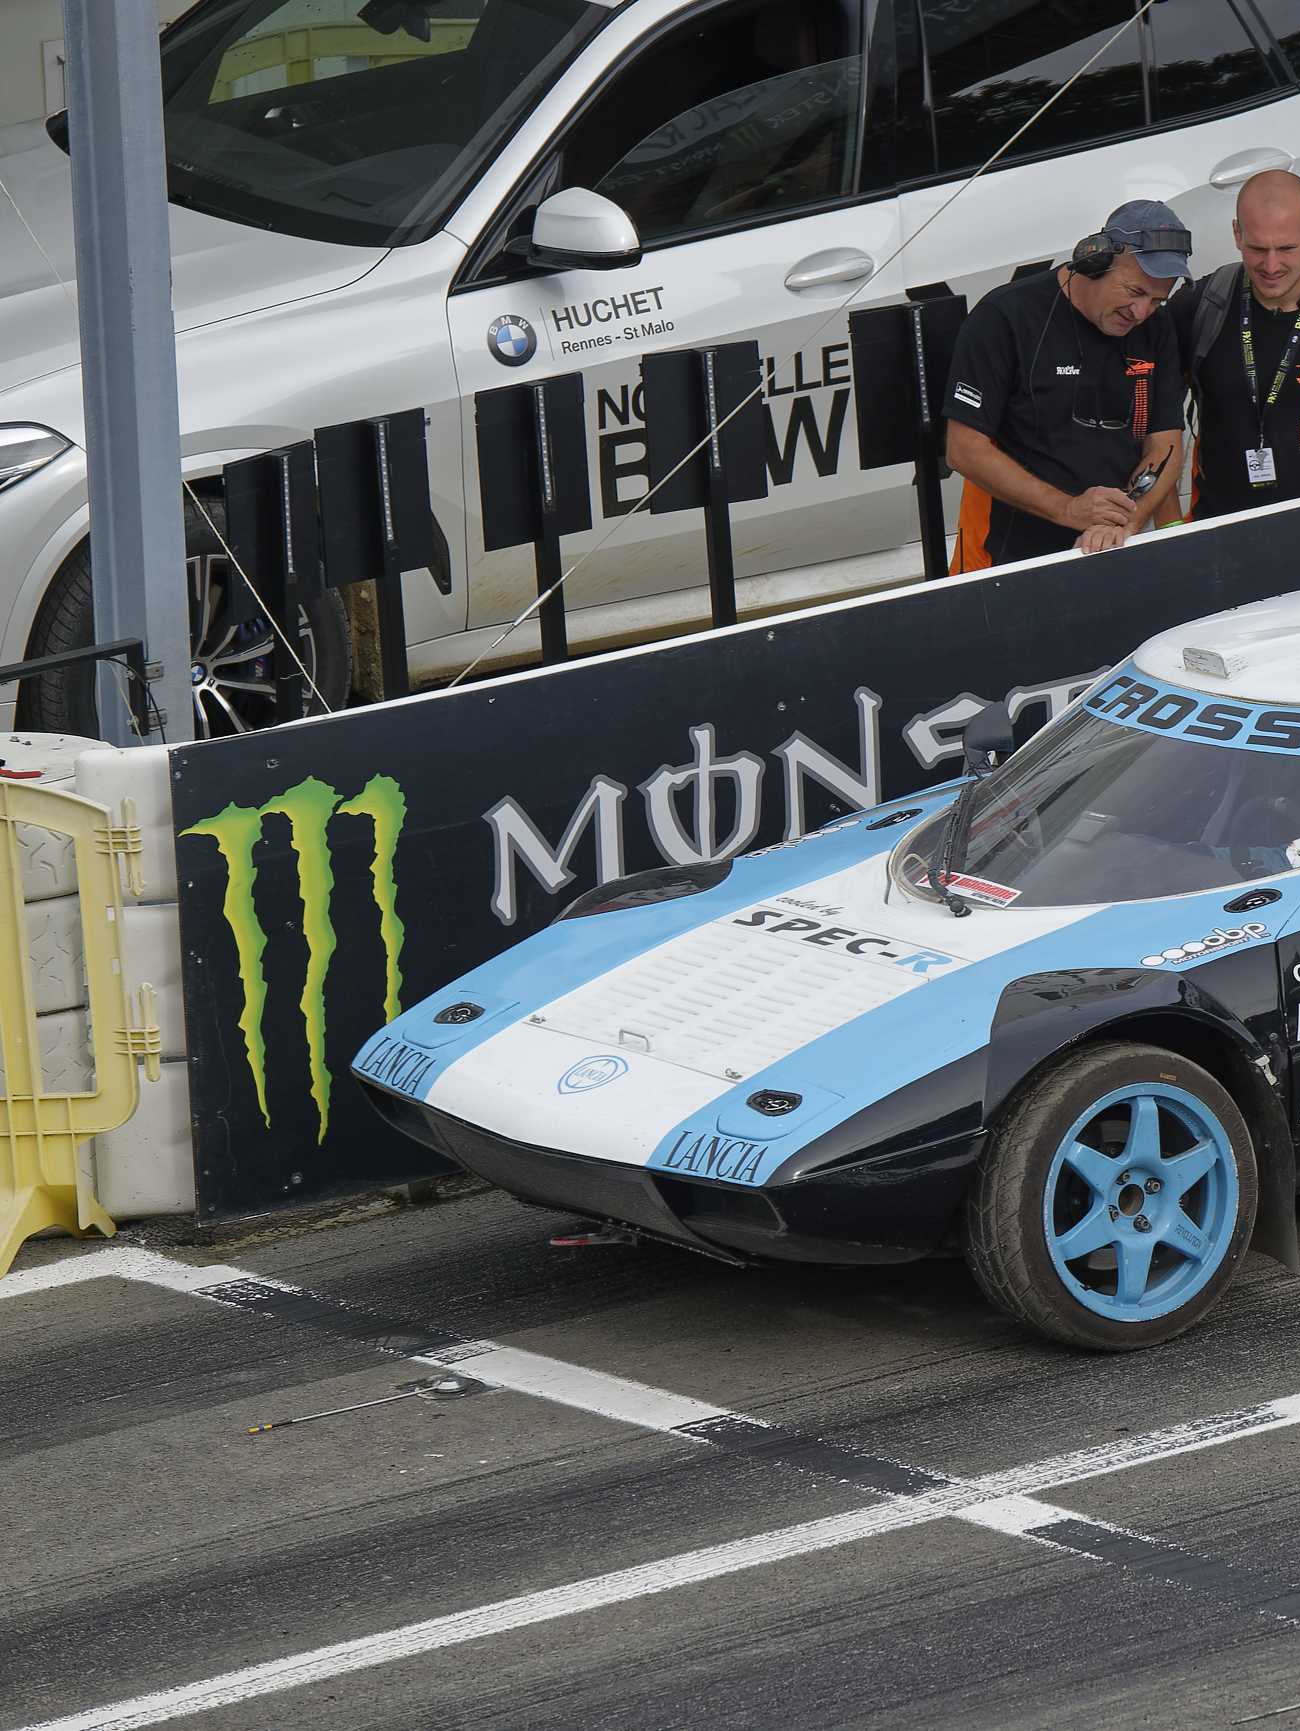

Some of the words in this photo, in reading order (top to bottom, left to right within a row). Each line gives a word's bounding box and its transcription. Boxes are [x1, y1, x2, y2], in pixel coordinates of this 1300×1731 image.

[489, 316, 529, 337] BMW
[551, 286, 664, 332] HUCHET
[561, 333, 612, 355] Rennes
[623, 327, 640, 342] St
[641, 319, 675, 338] Malo
[597, 343, 850, 430] NLLE
[599, 387, 851, 519] BW
[732, 910, 953, 973] SPEC-R
[1201, 922, 1268, 946] obp
[358, 1036, 437, 1096] LANCIA
[661, 1130, 769, 1183] LANCIA
